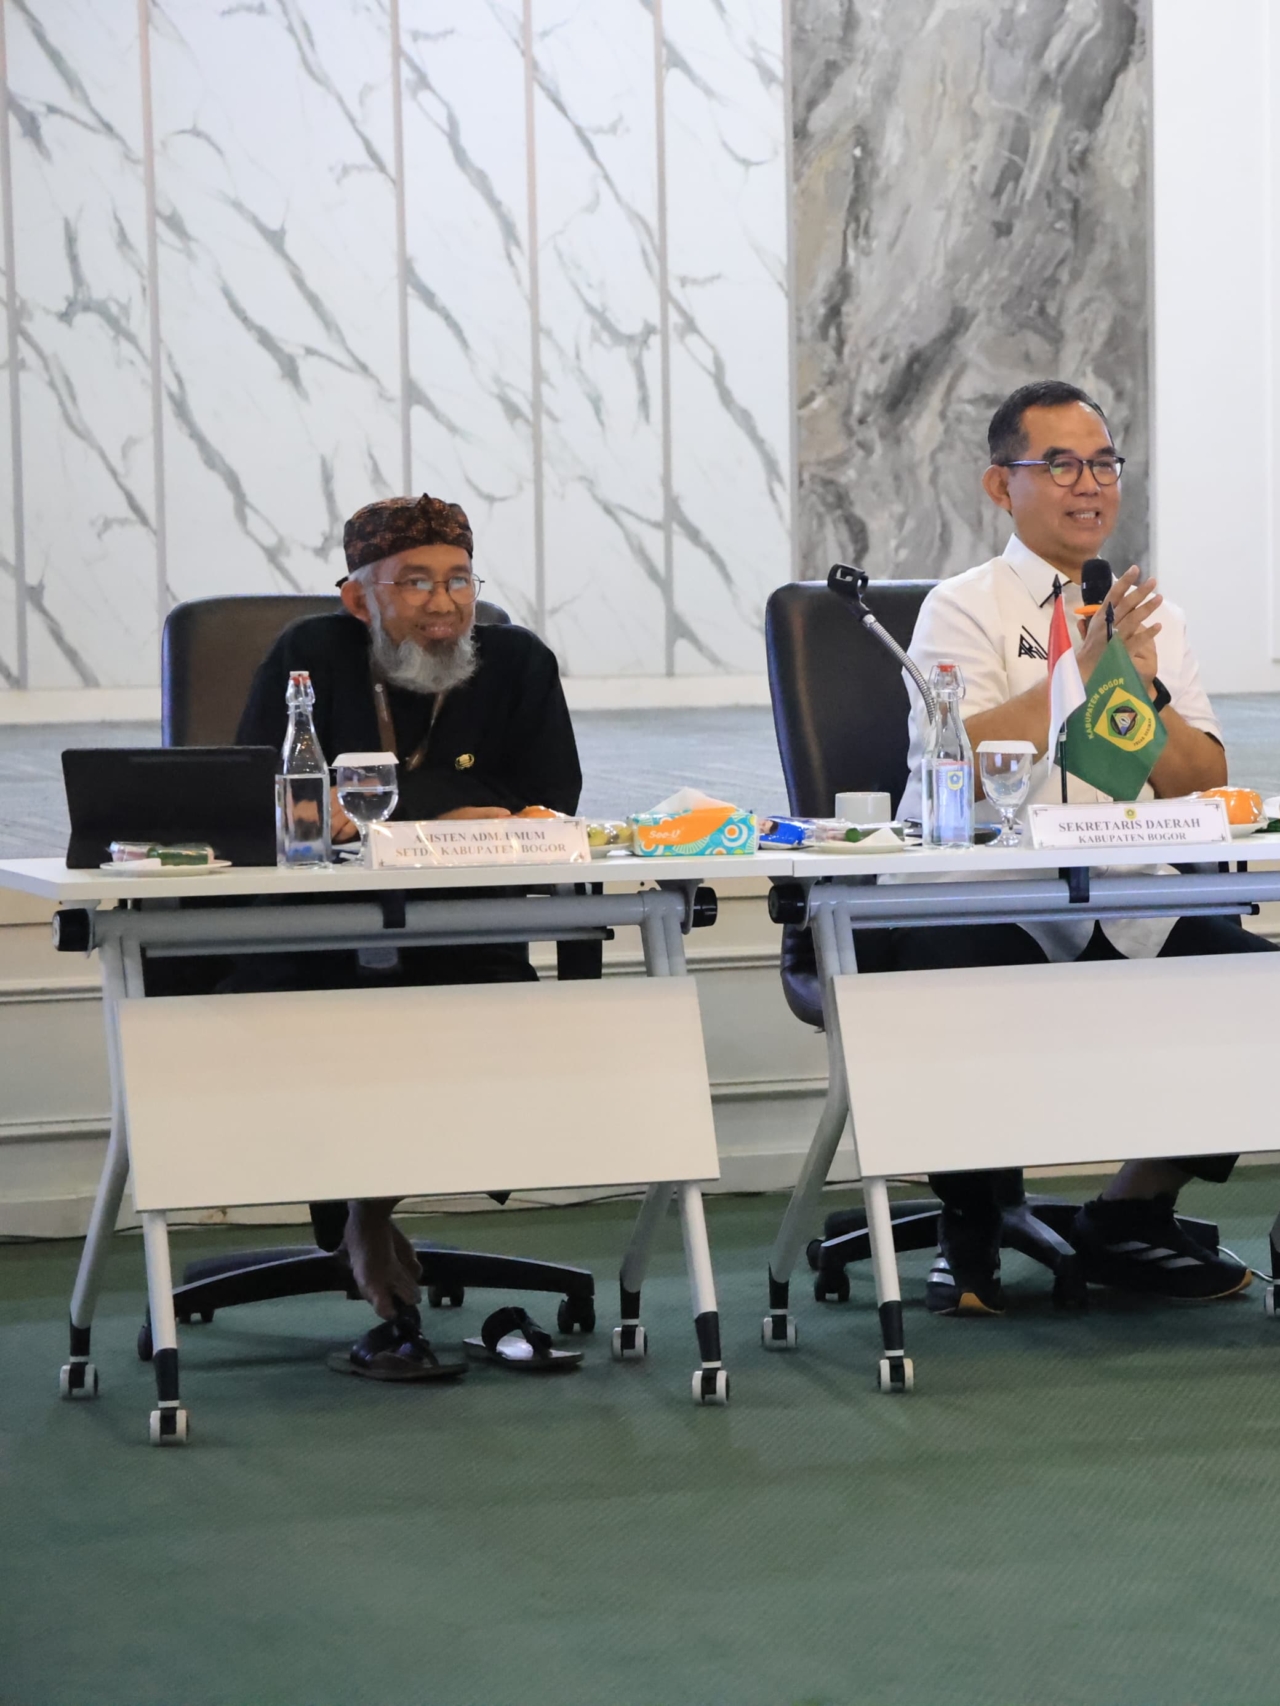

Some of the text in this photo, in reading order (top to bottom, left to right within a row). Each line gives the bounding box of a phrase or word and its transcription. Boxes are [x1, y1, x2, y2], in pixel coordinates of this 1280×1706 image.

[1085, 677, 1124, 739] KABUPATEN BOGOR
[1058, 818, 1201, 833] SEKRETARIS DAERAH
[470, 831, 502, 842] ADM.
[506, 830, 546, 841] UMUM
[1079, 832, 1187, 844] KABUPATEN BOGOR
[441, 845, 517, 857] KABUPATEN
[521, 843, 567, 853] BOGOR
